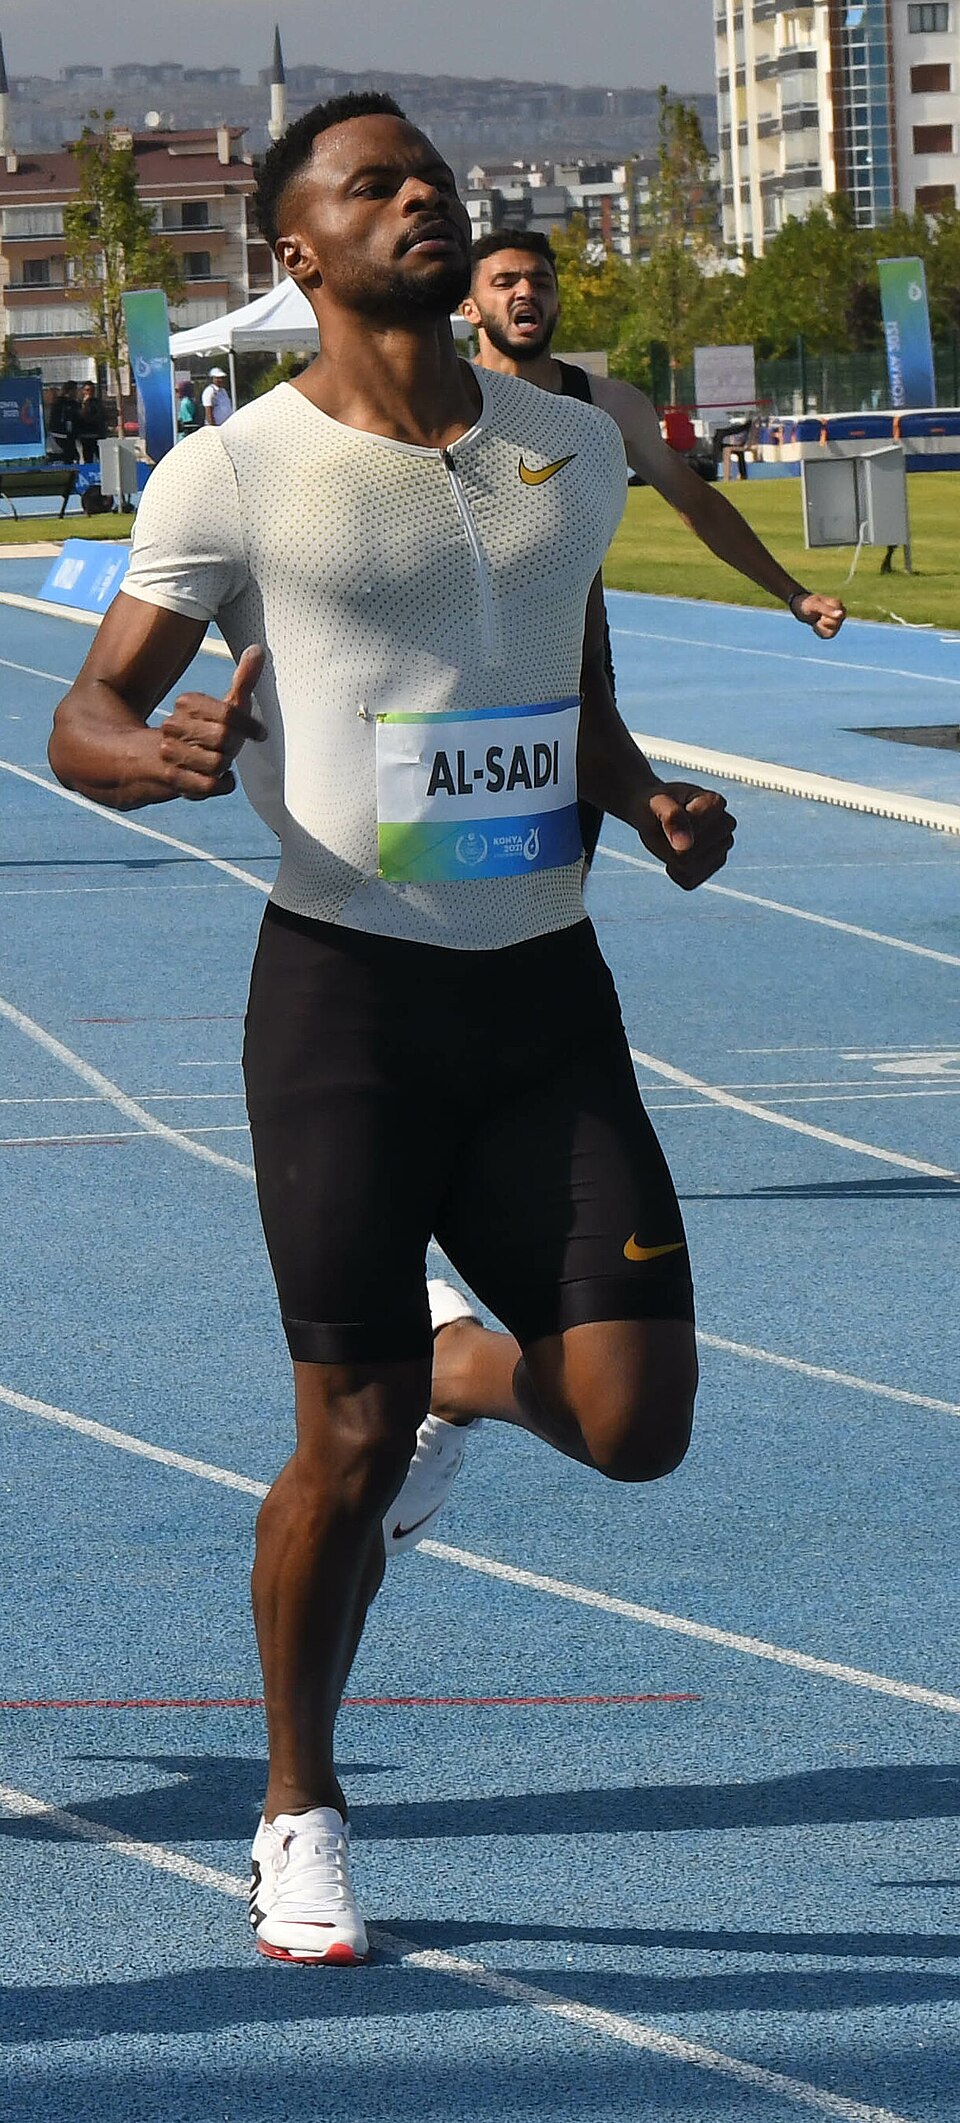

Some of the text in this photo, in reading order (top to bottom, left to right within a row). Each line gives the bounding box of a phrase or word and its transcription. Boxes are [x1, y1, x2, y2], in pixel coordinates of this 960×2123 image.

[426, 740, 559, 796] AL-SADI
[493, 835, 523, 846] KONYA
[503, 843, 523, 853] 2021
